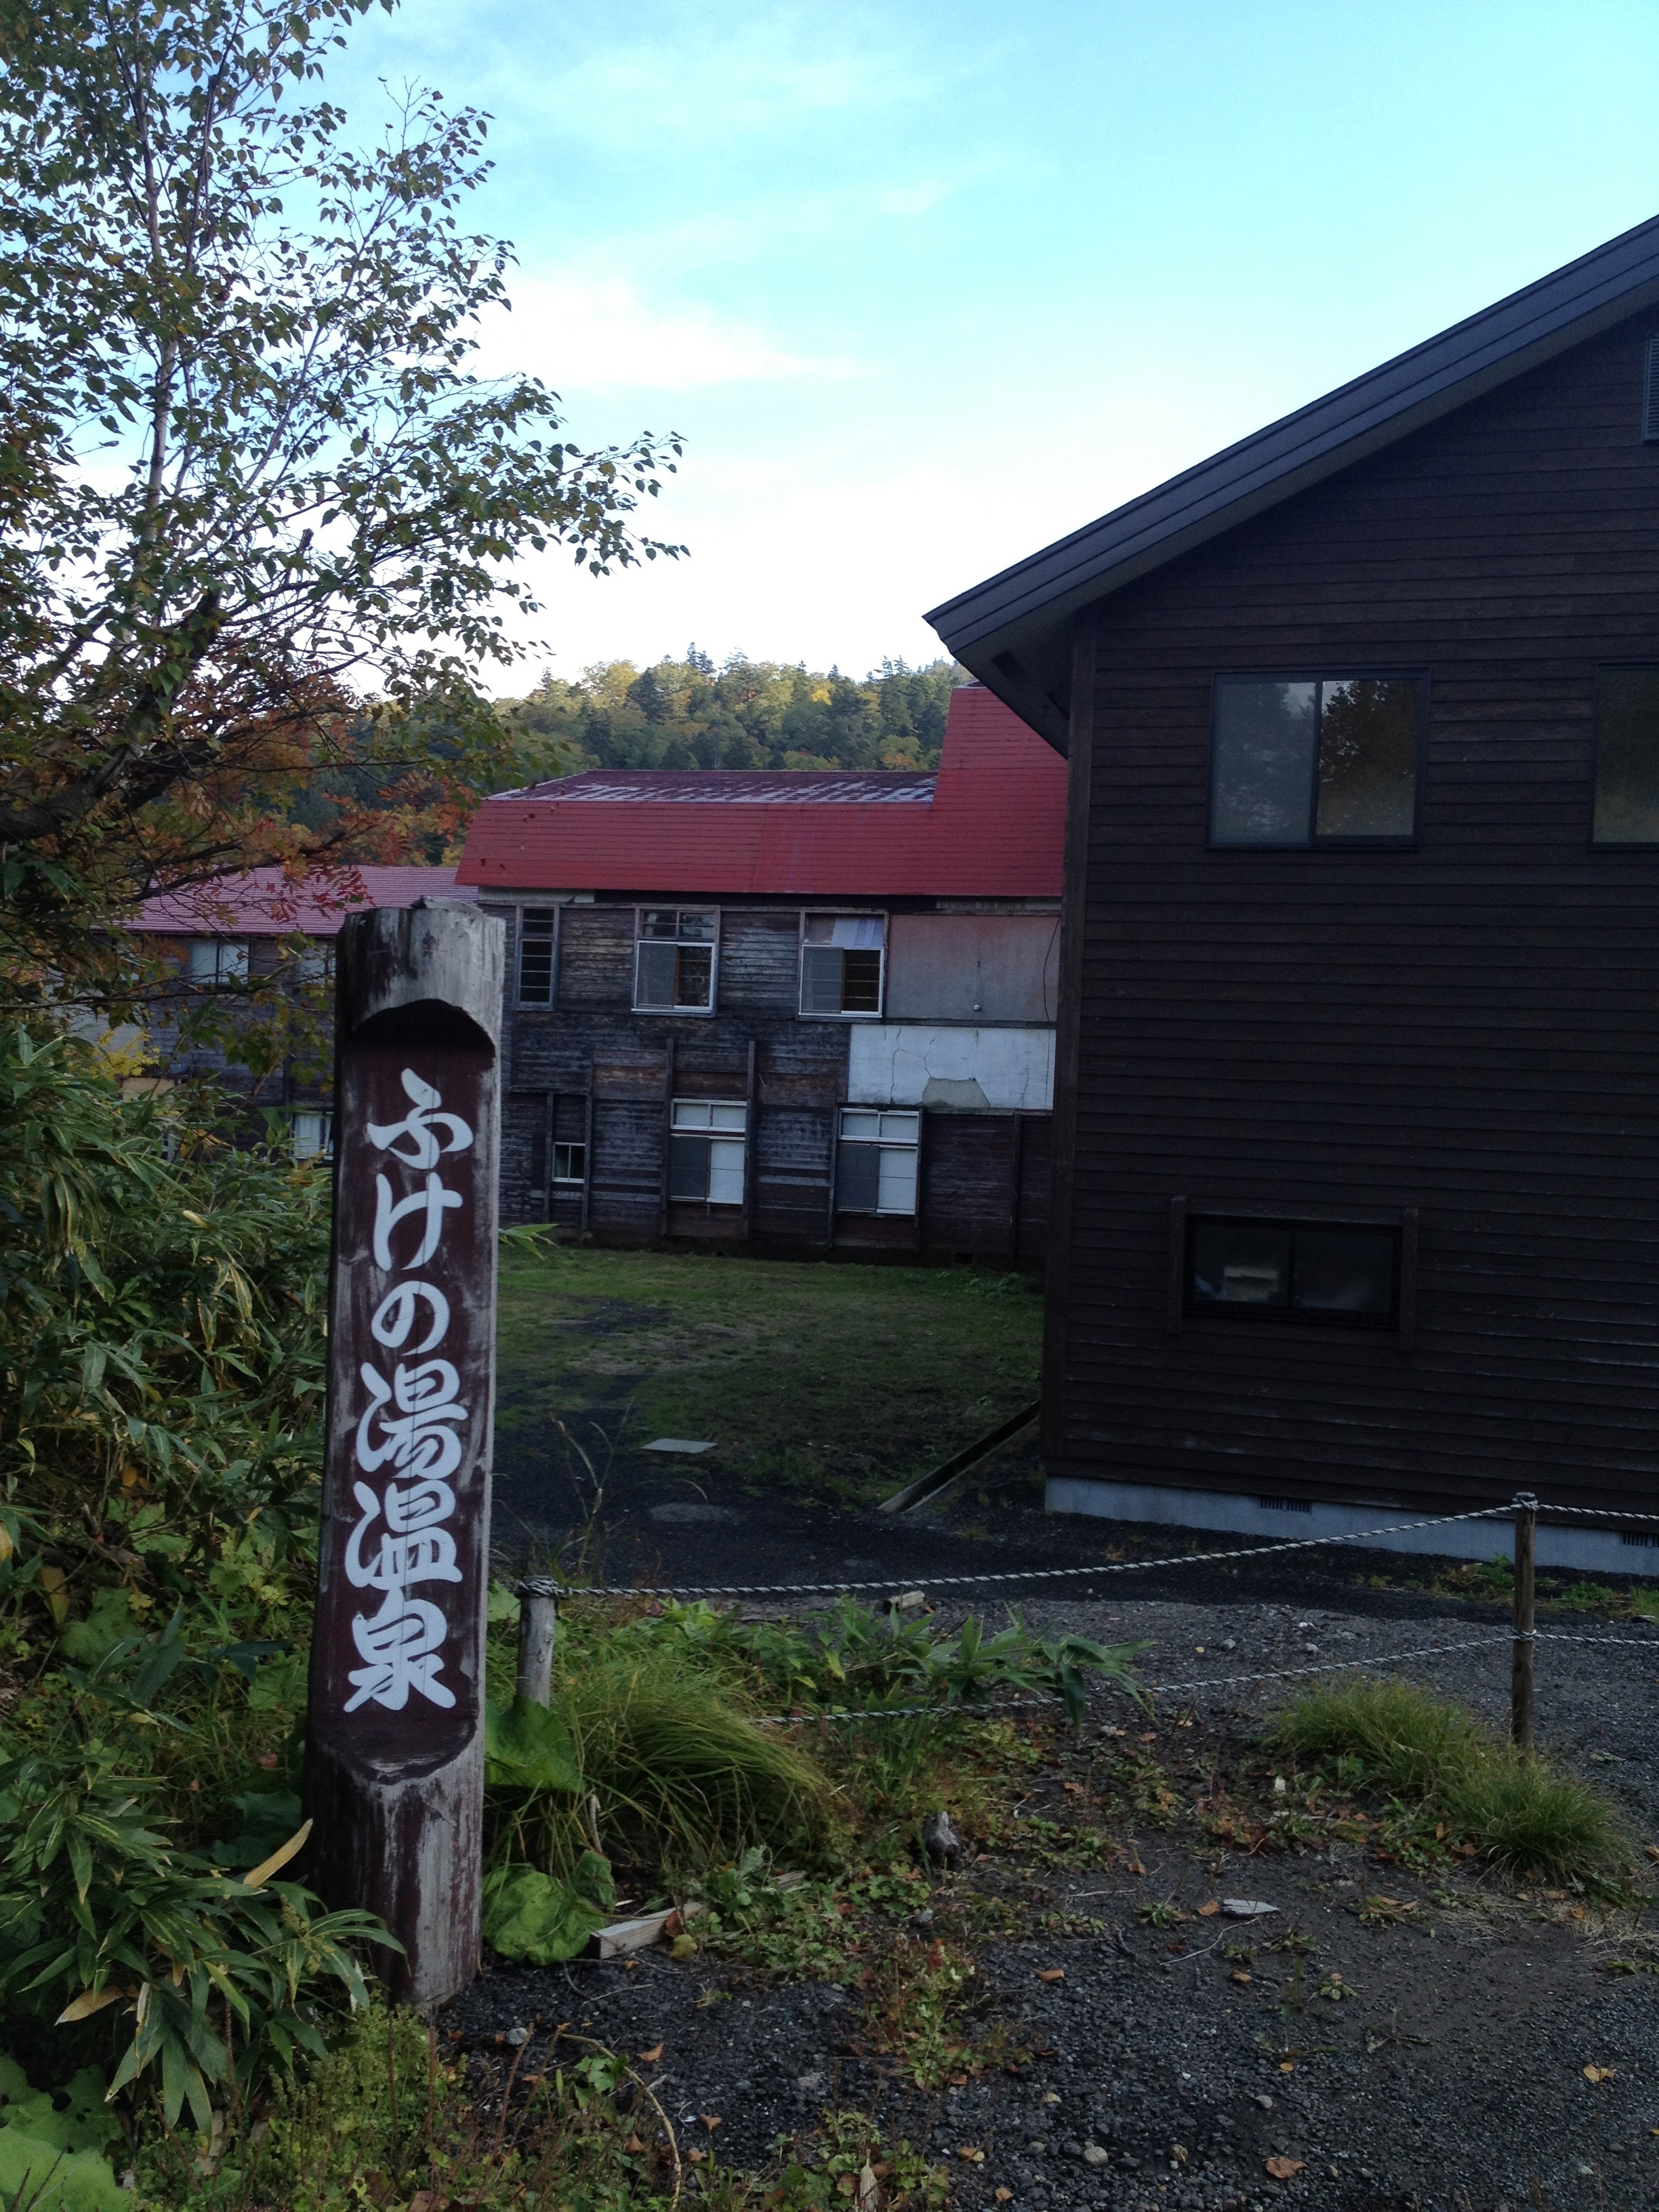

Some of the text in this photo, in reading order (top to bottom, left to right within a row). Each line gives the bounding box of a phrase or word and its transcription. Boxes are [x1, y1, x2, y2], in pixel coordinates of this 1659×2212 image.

[344, 1068, 474, 1713] ふけの湯温泉
